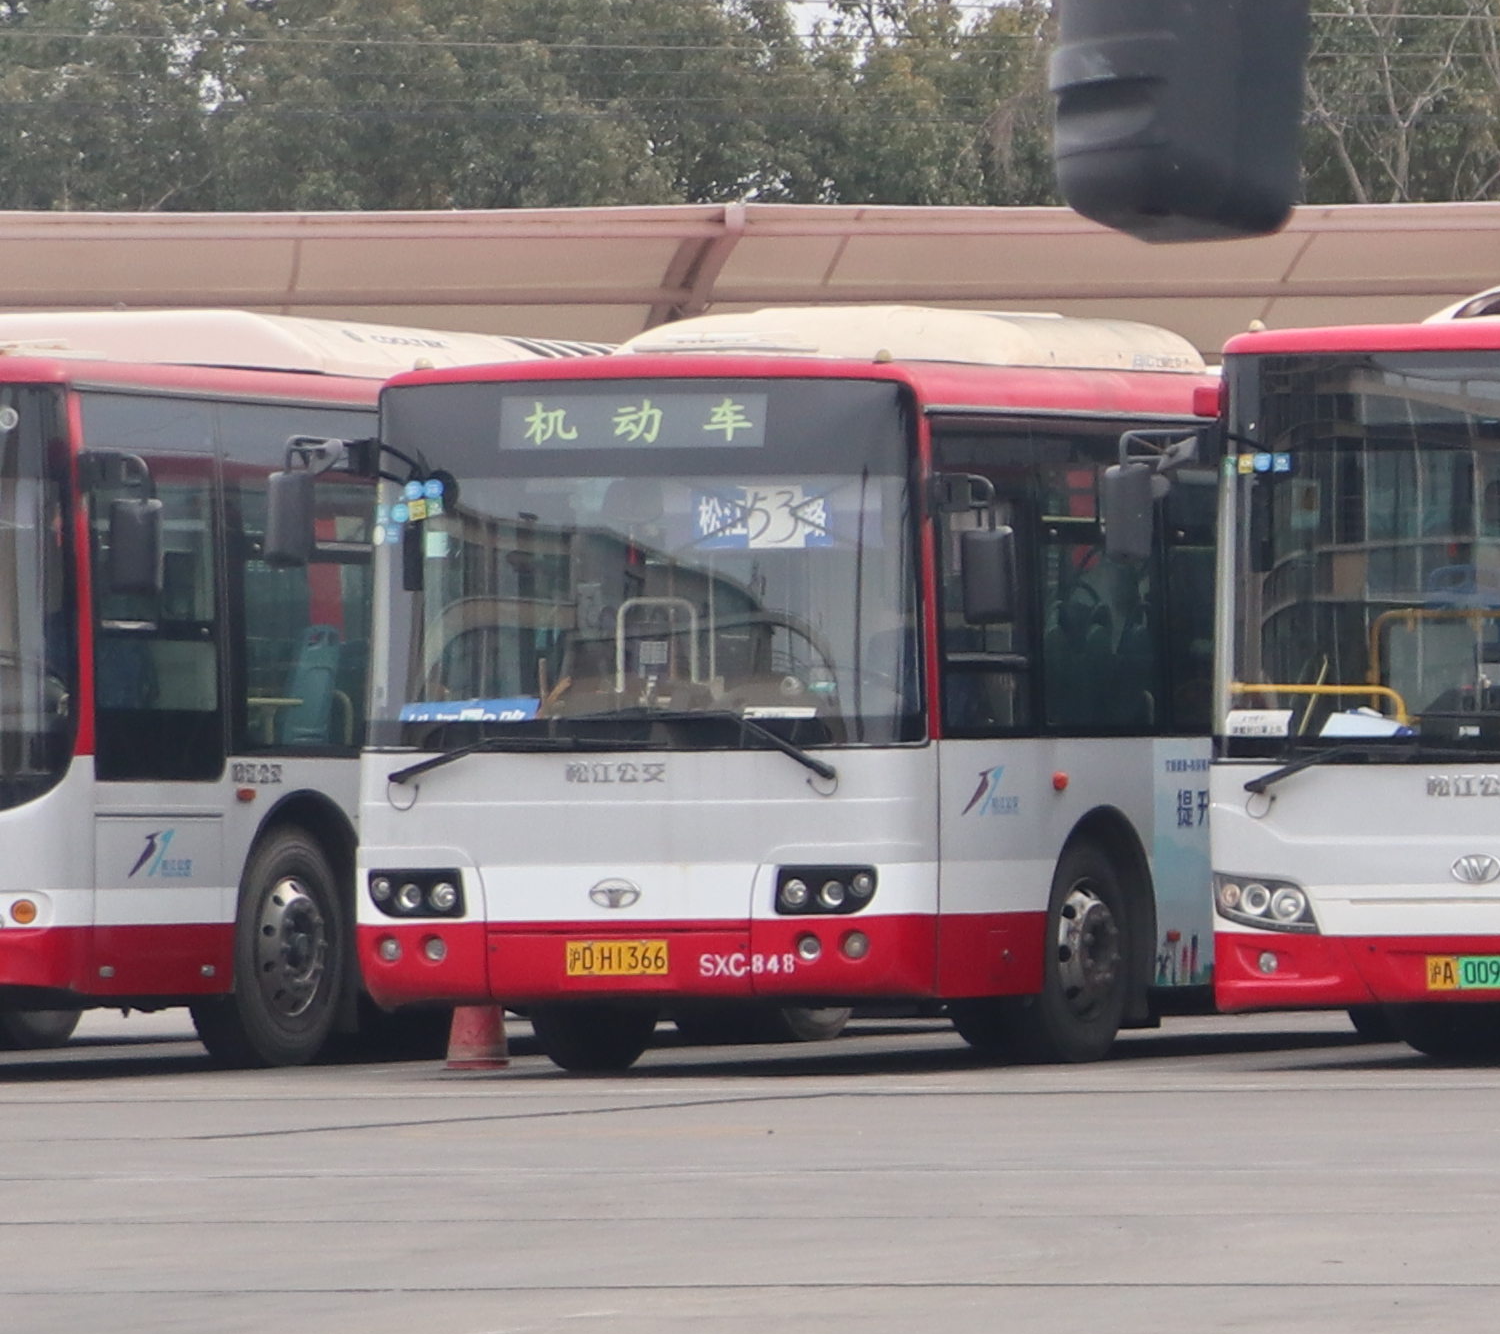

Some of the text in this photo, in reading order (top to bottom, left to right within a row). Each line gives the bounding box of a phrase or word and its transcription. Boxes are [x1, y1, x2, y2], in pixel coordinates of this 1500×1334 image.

[524, 397, 754, 446] 机动车
[566, 762, 666, 783] 松江公交
